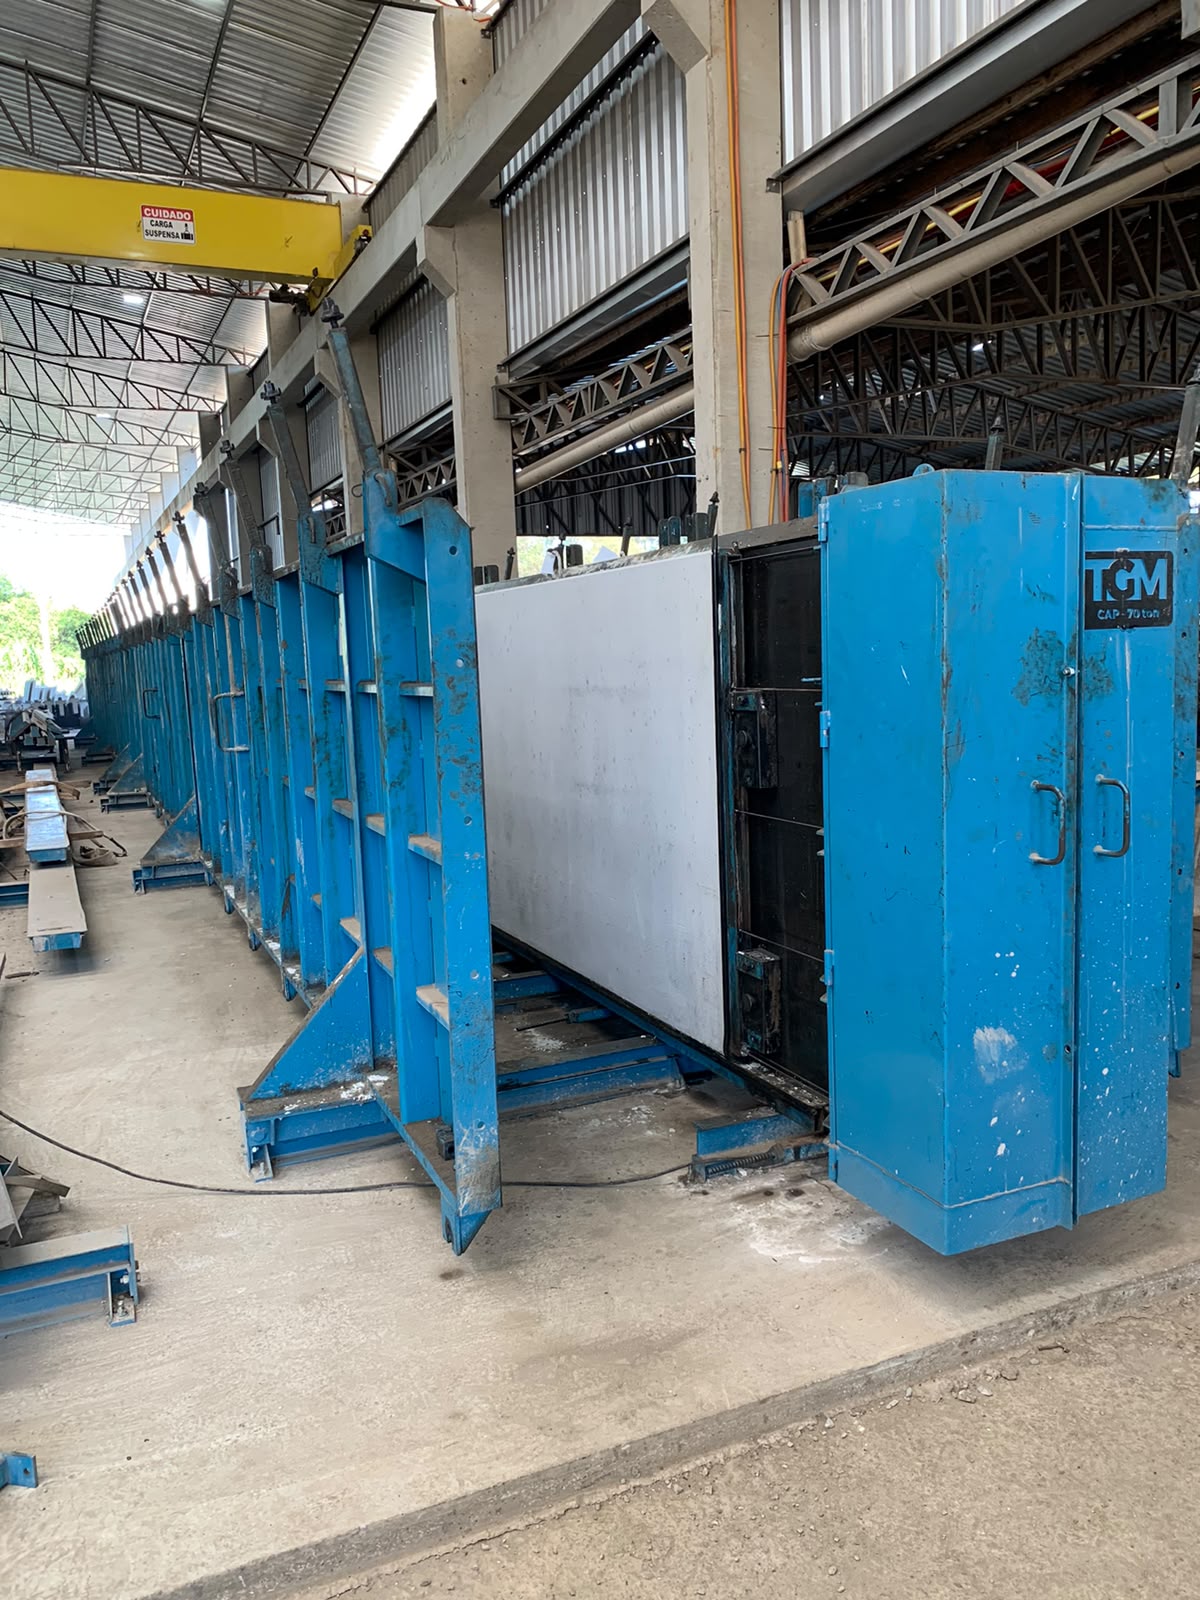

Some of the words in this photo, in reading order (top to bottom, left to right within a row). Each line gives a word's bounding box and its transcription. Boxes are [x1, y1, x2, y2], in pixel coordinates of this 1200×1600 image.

[144, 208, 191, 220] CUIDADO
[150, 219, 173, 228] CARGA
[145, 229, 180, 239] SUSPENSA
[1142, 608, 1160, 619] ton
